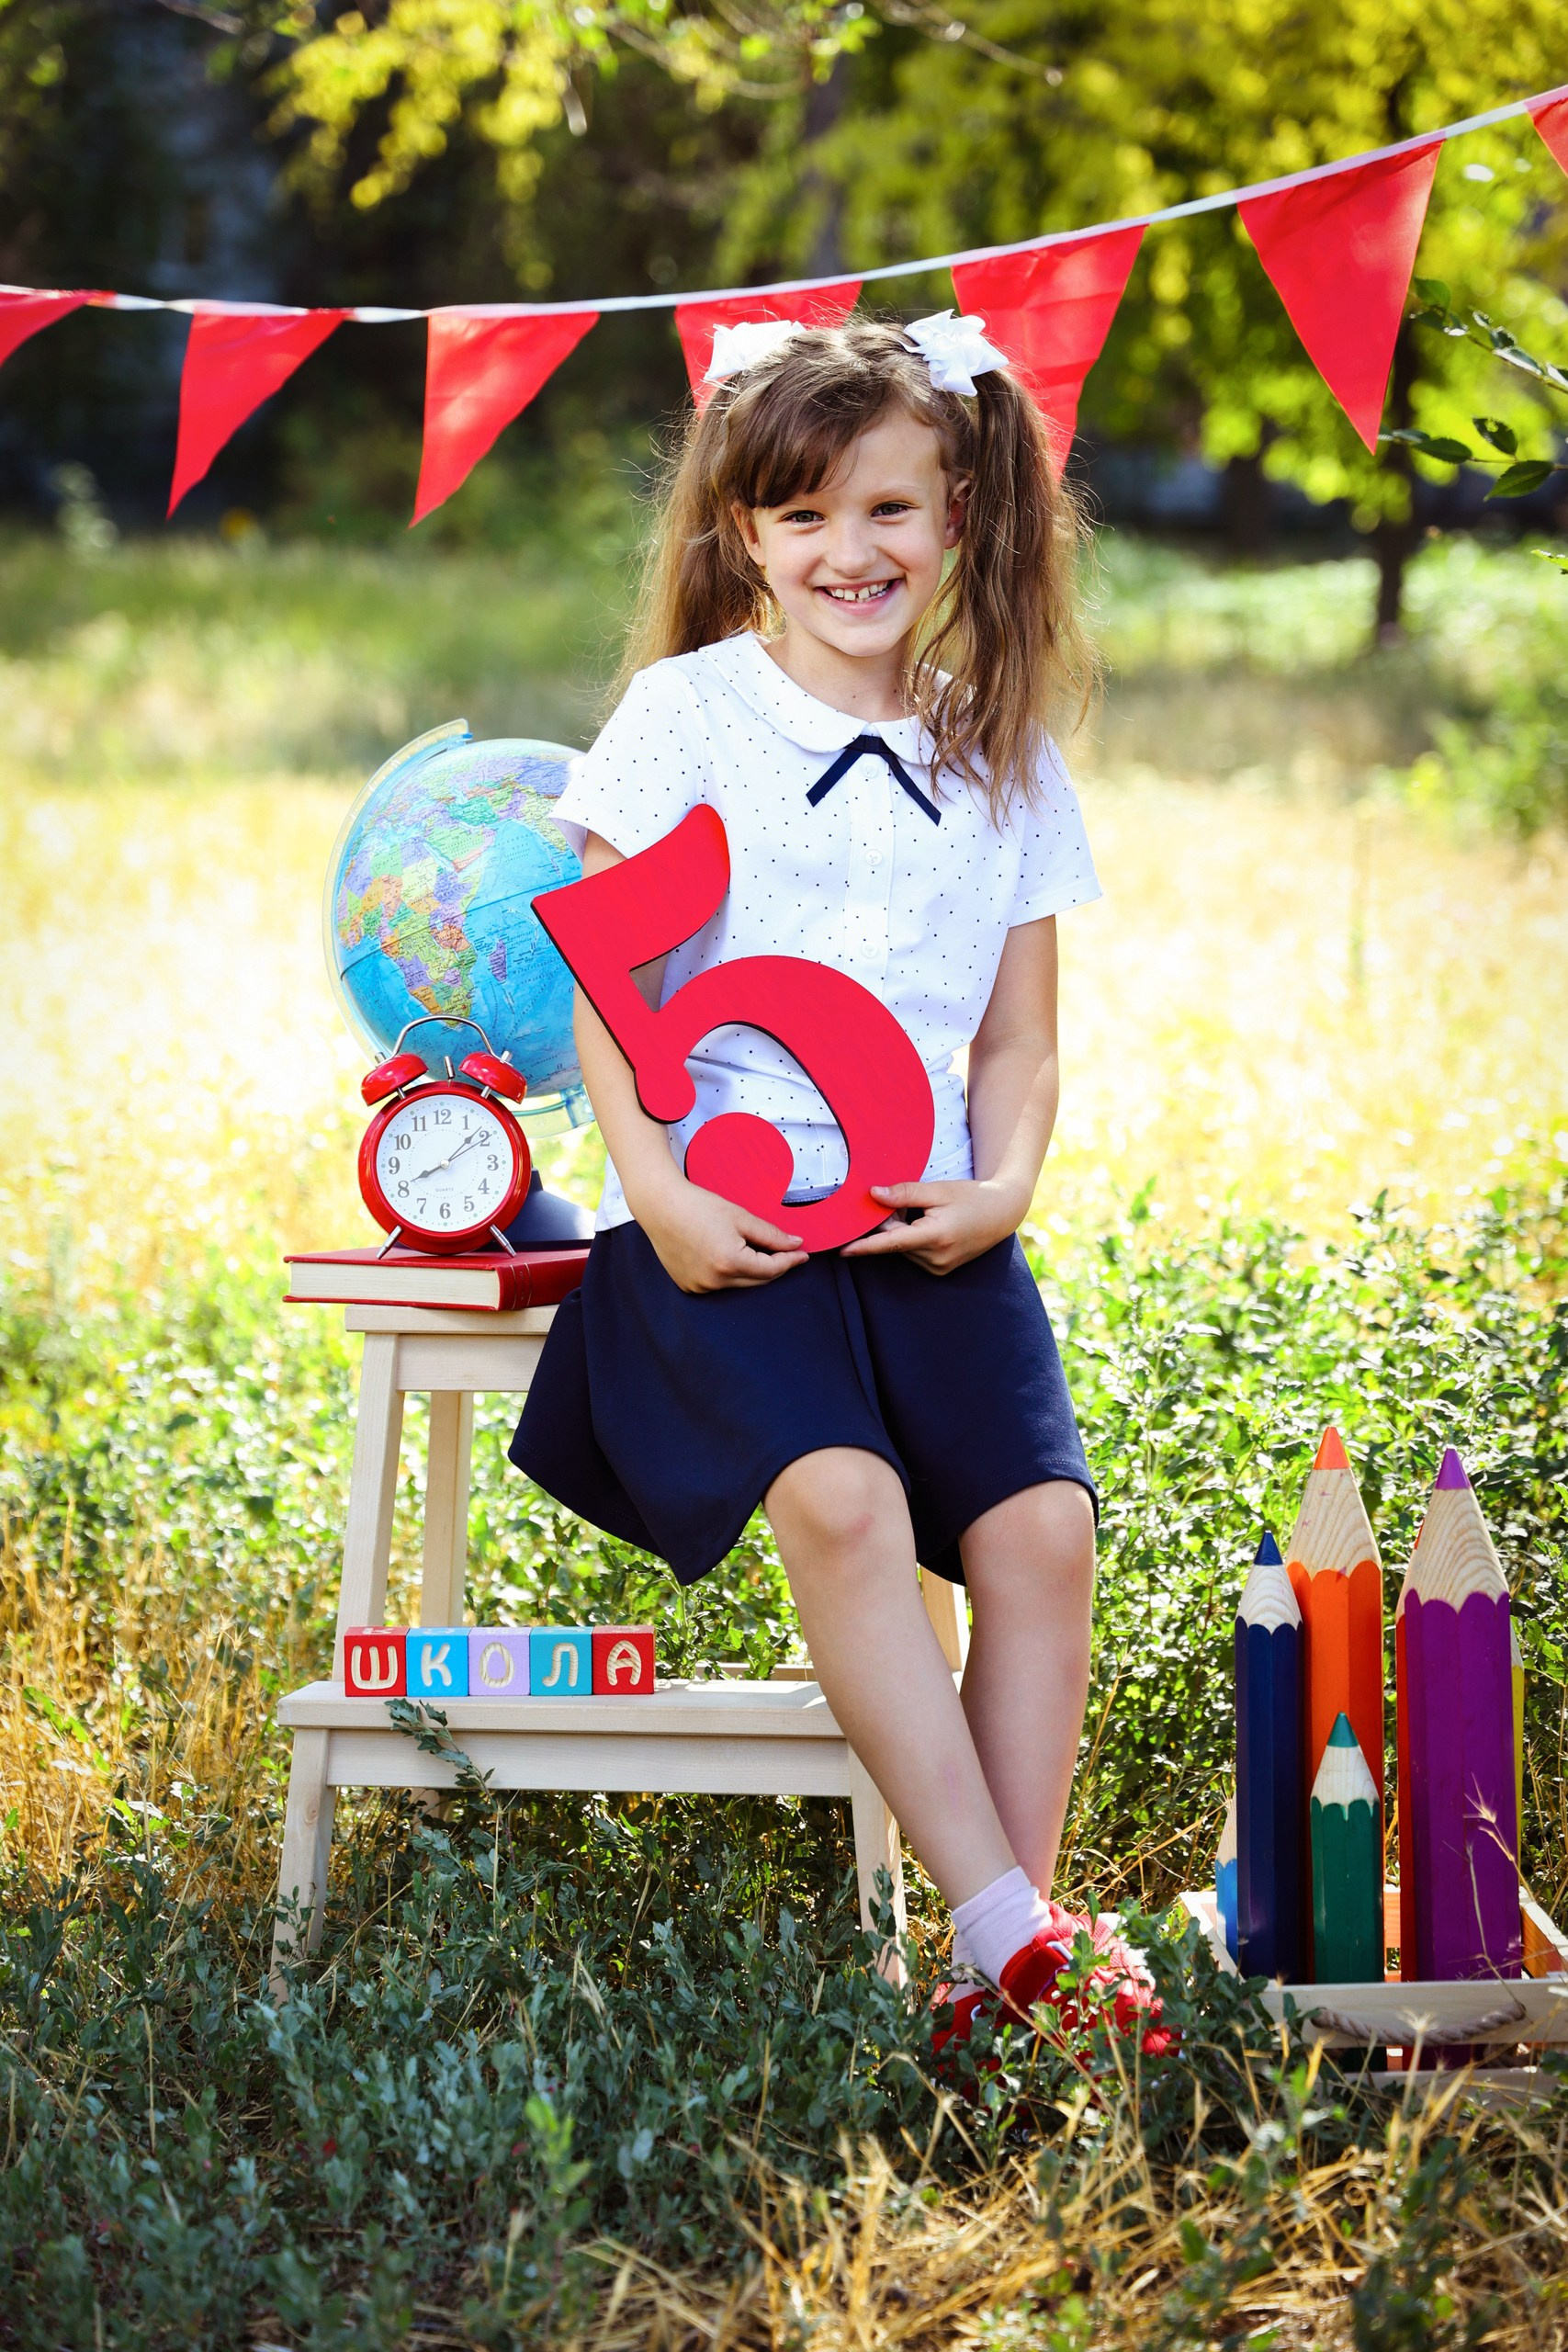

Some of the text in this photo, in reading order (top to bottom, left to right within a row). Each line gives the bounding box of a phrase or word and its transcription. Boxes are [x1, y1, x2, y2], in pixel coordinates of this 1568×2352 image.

[530, 803, 935, 1253] 5
[412, 1115, 427, 1132] 11
[433, 1108, 452, 1125] 12
[462, 1114, 469, 1130] 1
[393, 1133, 412, 1151] 10
[479, 1130, 491, 1148] 2
[388, 1156, 400, 1175] 9
[487, 1154, 499, 1171] 3
[397, 1180, 410, 1199] 8
[477, 1178, 490, 1194] 4
[416, 1197, 427, 1215] 7
[439, 1202, 451, 1219] 6
[463, 1195, 475, 1212] 5
[351, 1640, 642, 1690] ШКОЛА
